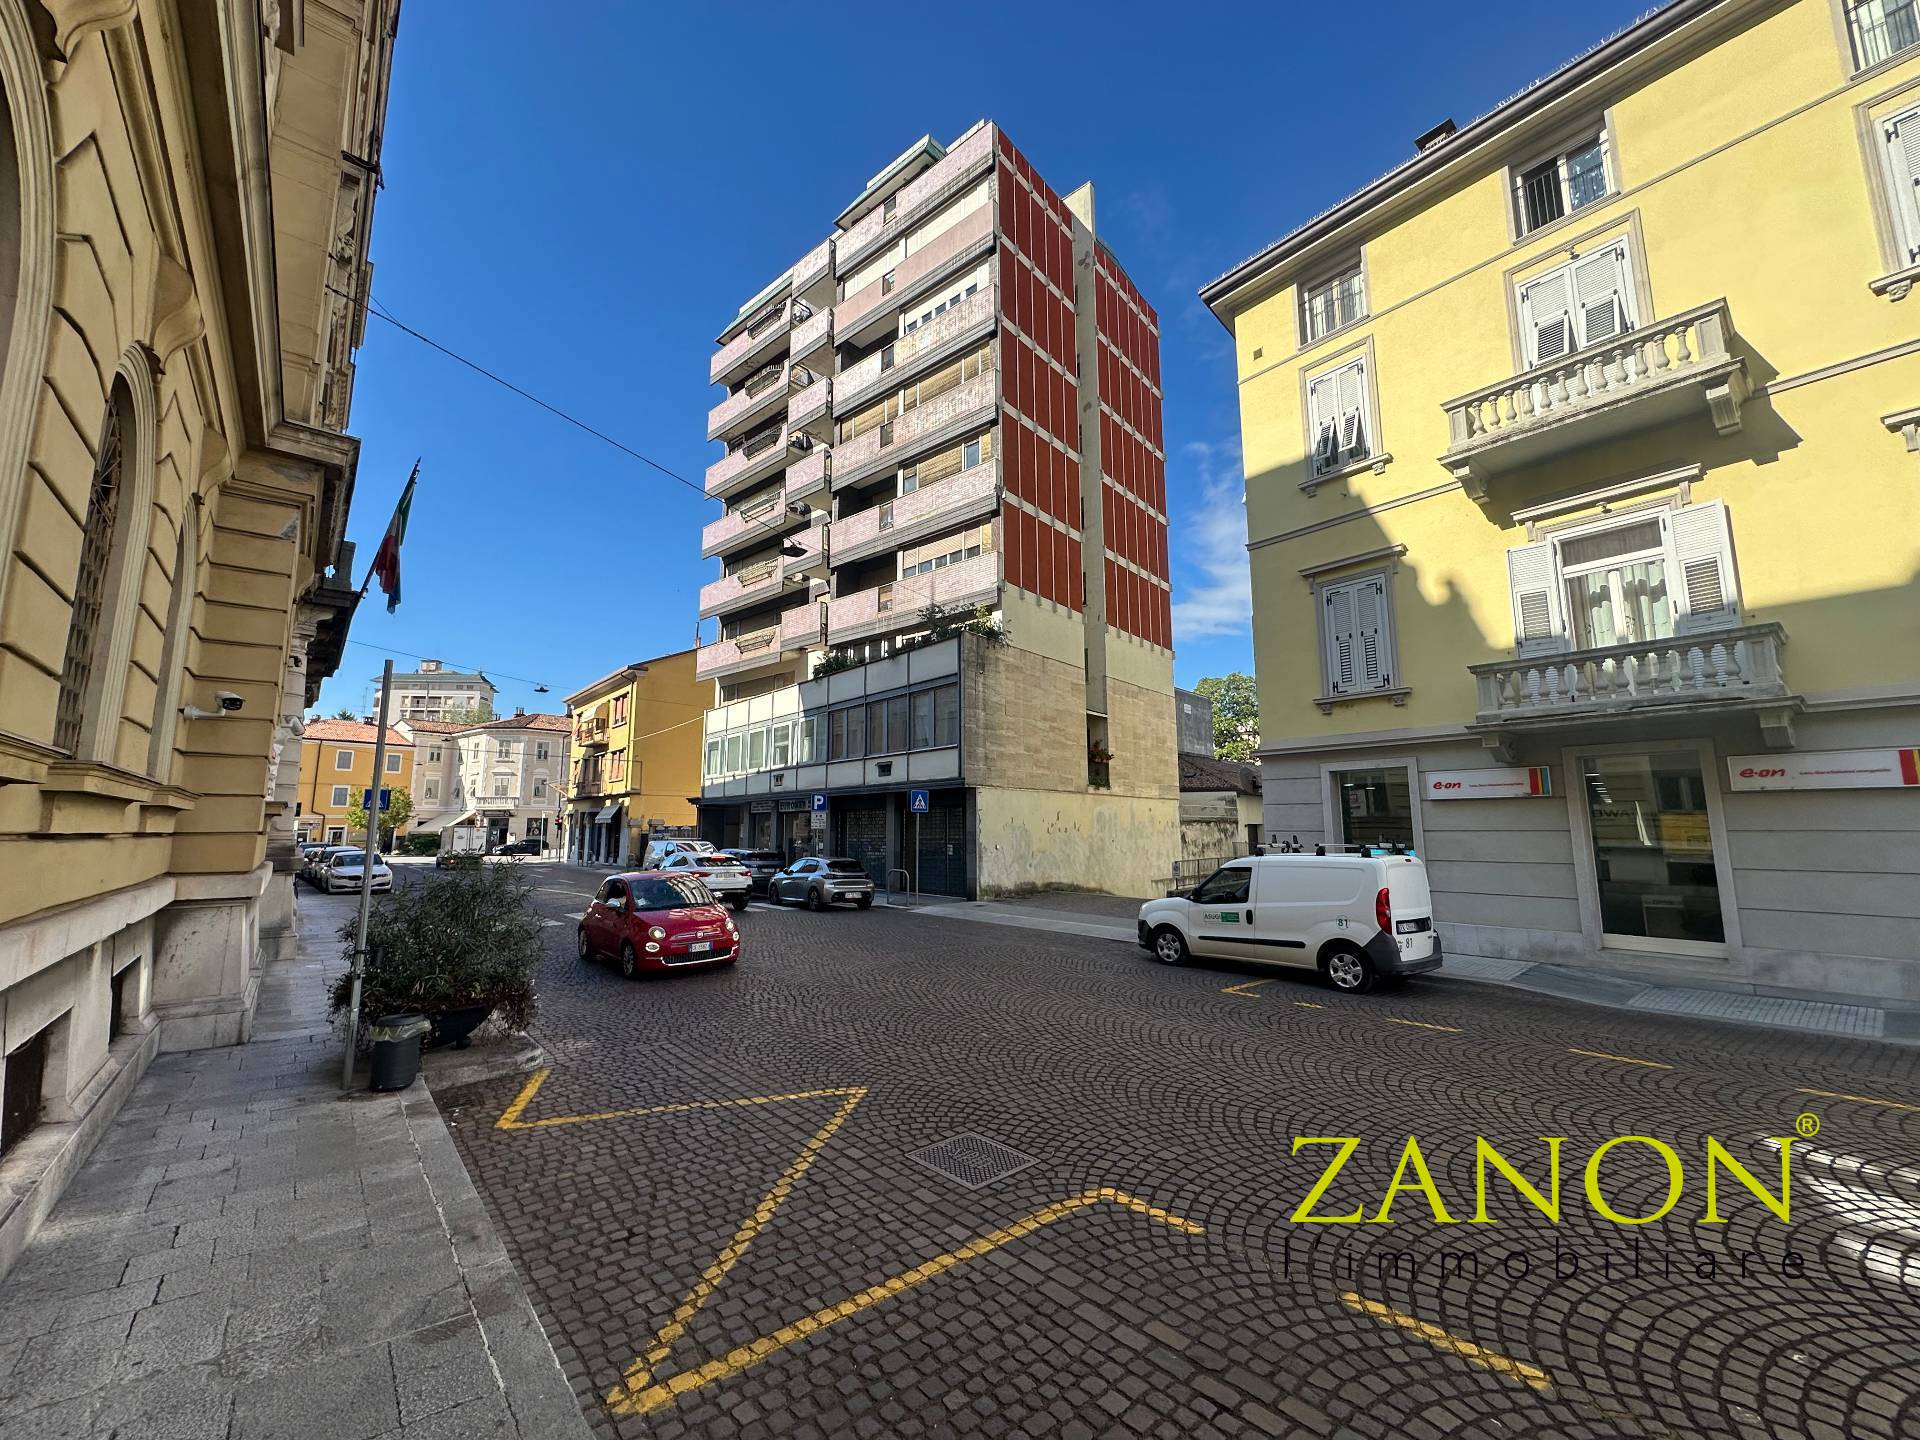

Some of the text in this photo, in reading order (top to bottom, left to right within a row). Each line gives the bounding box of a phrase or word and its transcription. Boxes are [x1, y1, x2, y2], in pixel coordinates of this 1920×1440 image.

[814, 795, 824, 810] P
[1337, 918, 1349, 928] 81
[1405, 937, 1413, 949] 81
